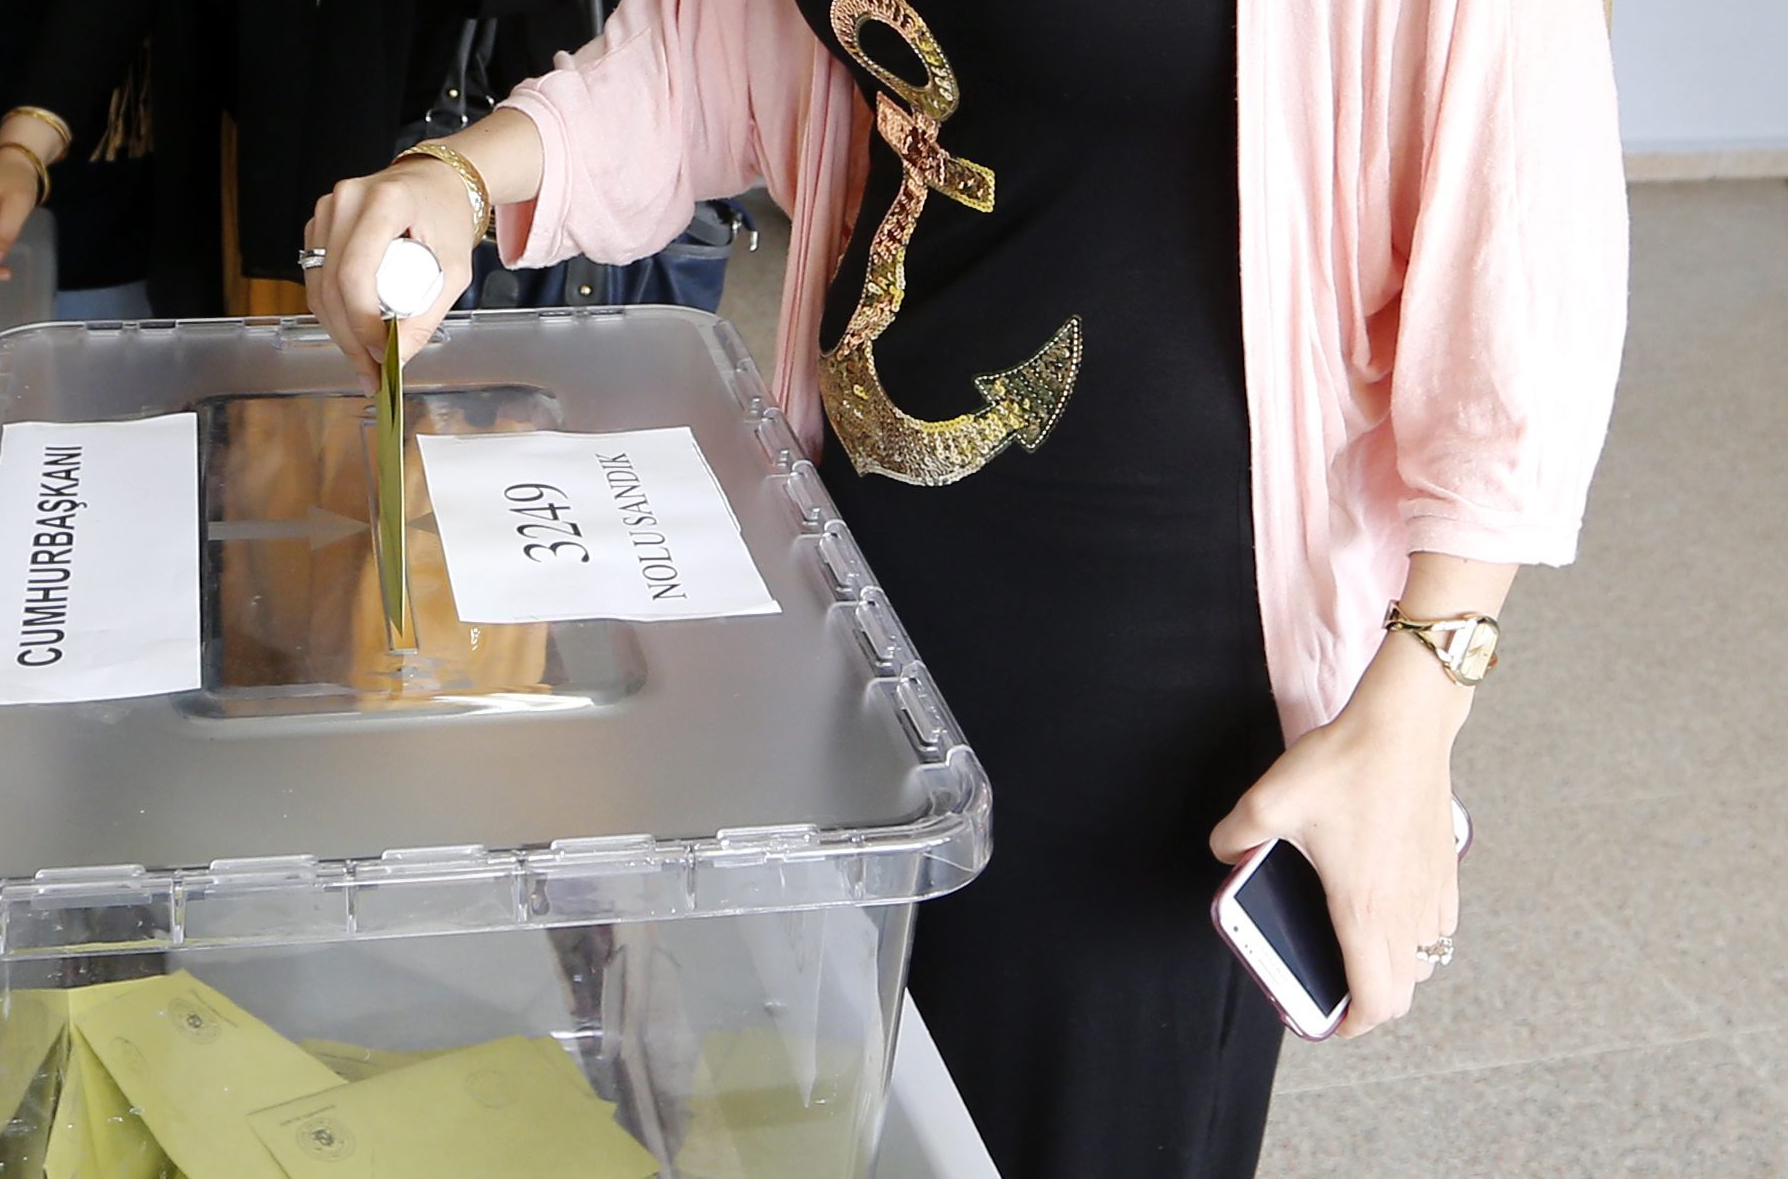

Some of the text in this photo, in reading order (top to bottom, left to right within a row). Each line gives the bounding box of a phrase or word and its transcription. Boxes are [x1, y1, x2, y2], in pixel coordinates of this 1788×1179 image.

[17, 446, 87, 667] CUMHURBAŞKANI
[503, 483, 590, 563] 3249
[595, 453, 688, 600] NOLU SANDIK
